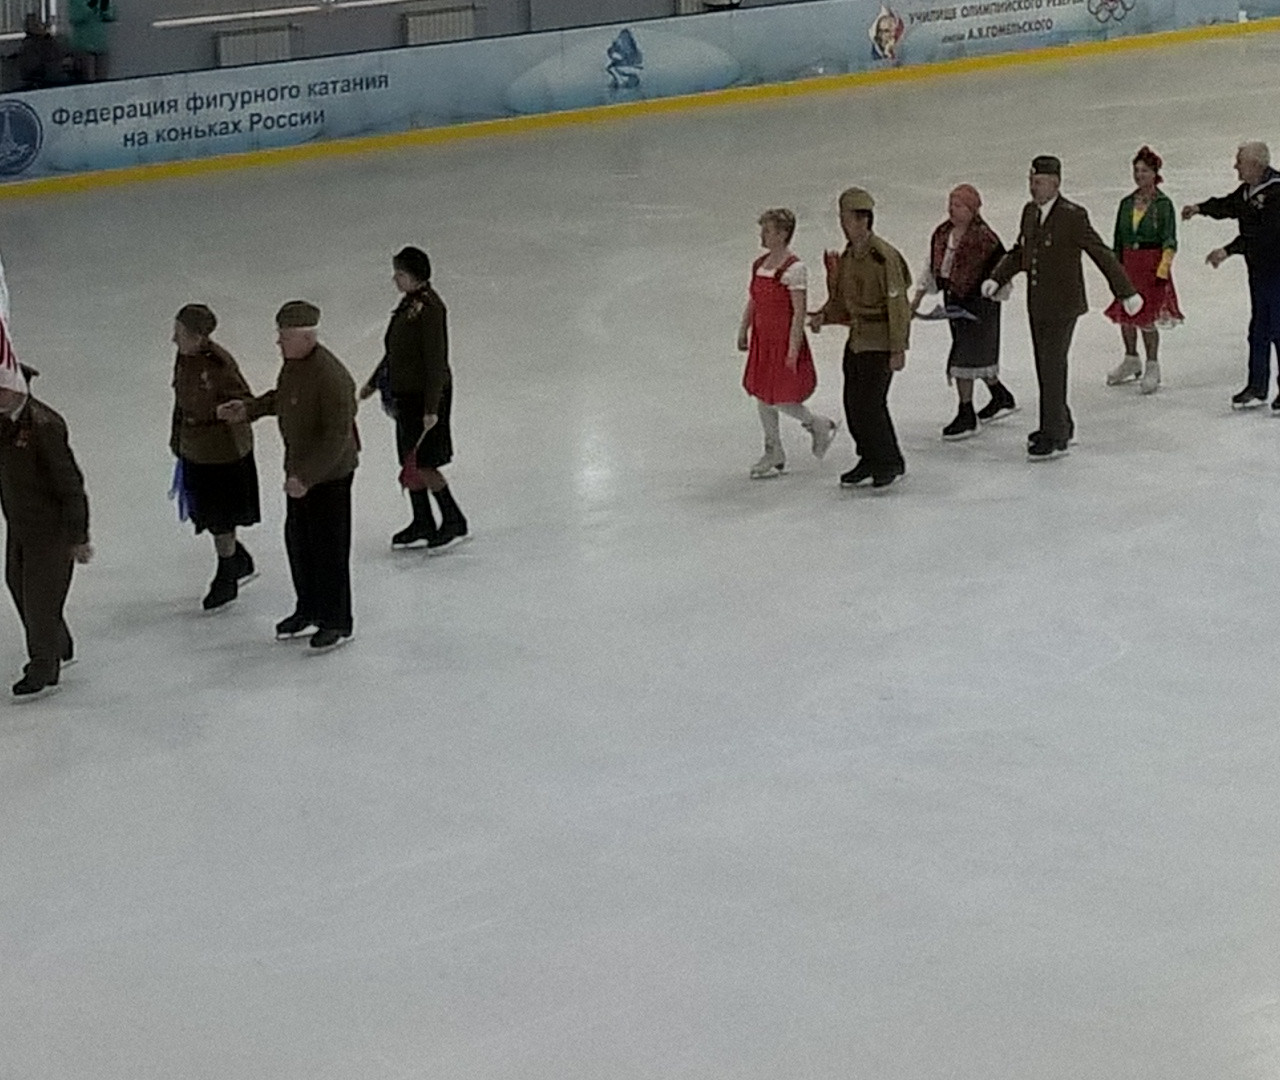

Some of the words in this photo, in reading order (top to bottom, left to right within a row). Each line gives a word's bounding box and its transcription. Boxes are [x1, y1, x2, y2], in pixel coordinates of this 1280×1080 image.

[51, 96, 178, 127] Федерация
[186, 81, 301, 115] фигурного
[307, 73, 390, 98] катания
[122, 128, 149, 148] на
[155, 117, 243, 143] коньках
[249, 107, 326, 133] России
